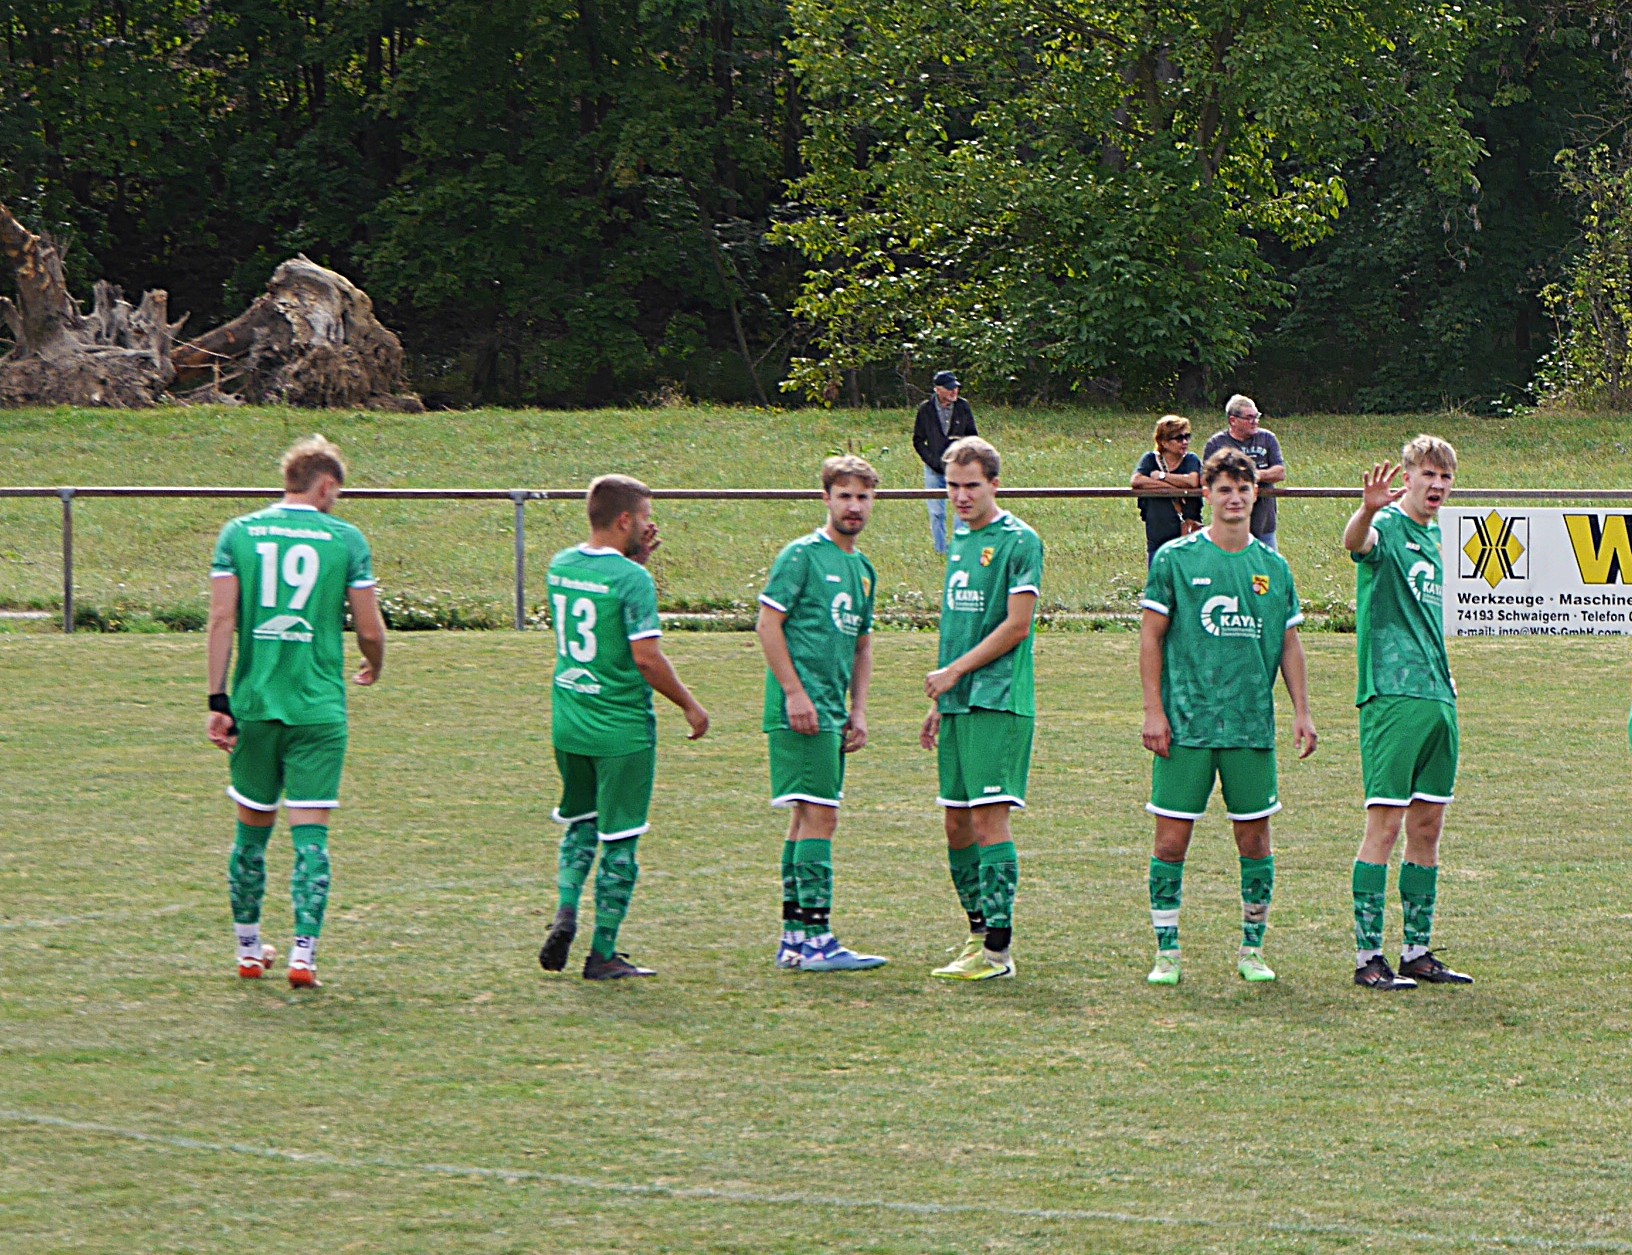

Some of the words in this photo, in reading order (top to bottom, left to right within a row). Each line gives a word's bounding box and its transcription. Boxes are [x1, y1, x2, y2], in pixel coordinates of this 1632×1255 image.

[256, 541, 320, 610] 19
[1457, 593, 1545, 608] Werkzeuge
[1220, 614, 1257, 628] KAYA
[1457, 609, 1494, 621] 74193
[1497, 609, 1570, 624] Schwaigern
[1580, 610, 1625, 622] Telefon
[552, 593, 597, 662] 13
